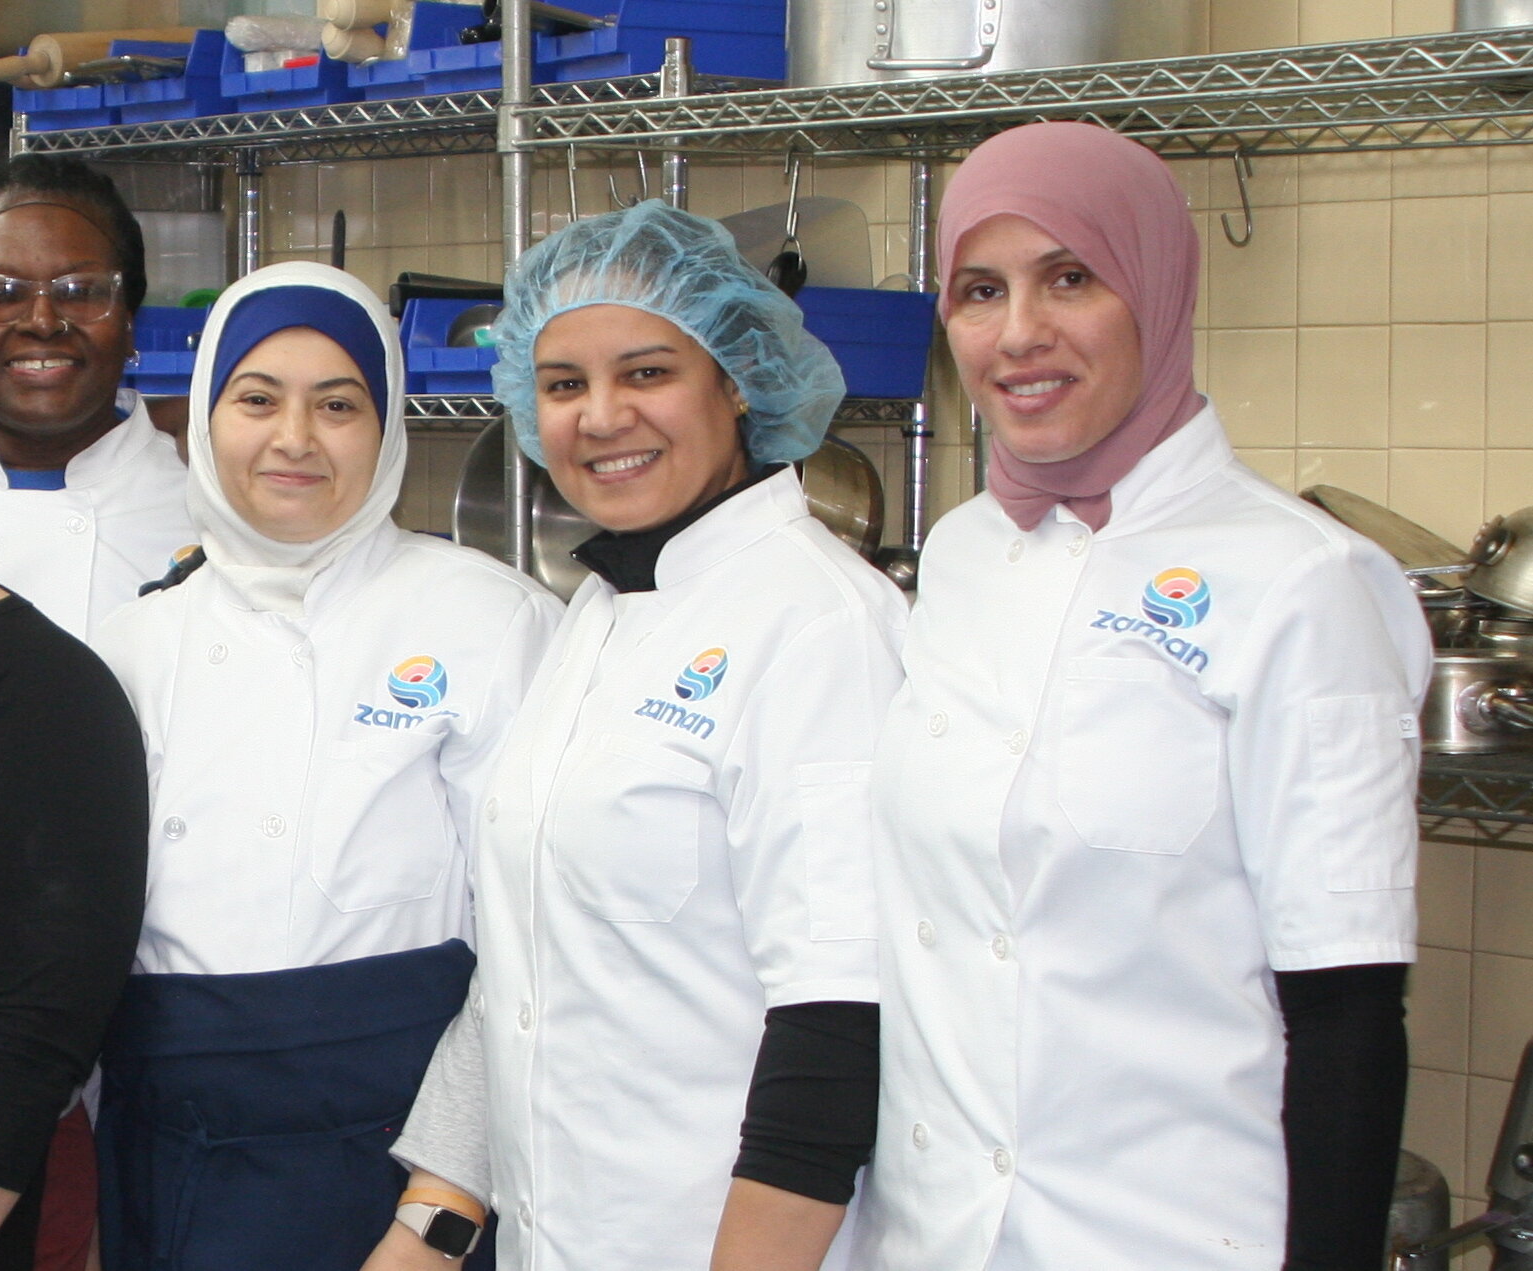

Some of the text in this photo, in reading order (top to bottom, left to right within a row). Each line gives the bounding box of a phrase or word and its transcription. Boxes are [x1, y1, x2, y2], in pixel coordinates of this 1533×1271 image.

[1089, 609, 1209, 674] zaman
[353, 703, 461, 729] zam
[633, 698, 716, 740] zaman
